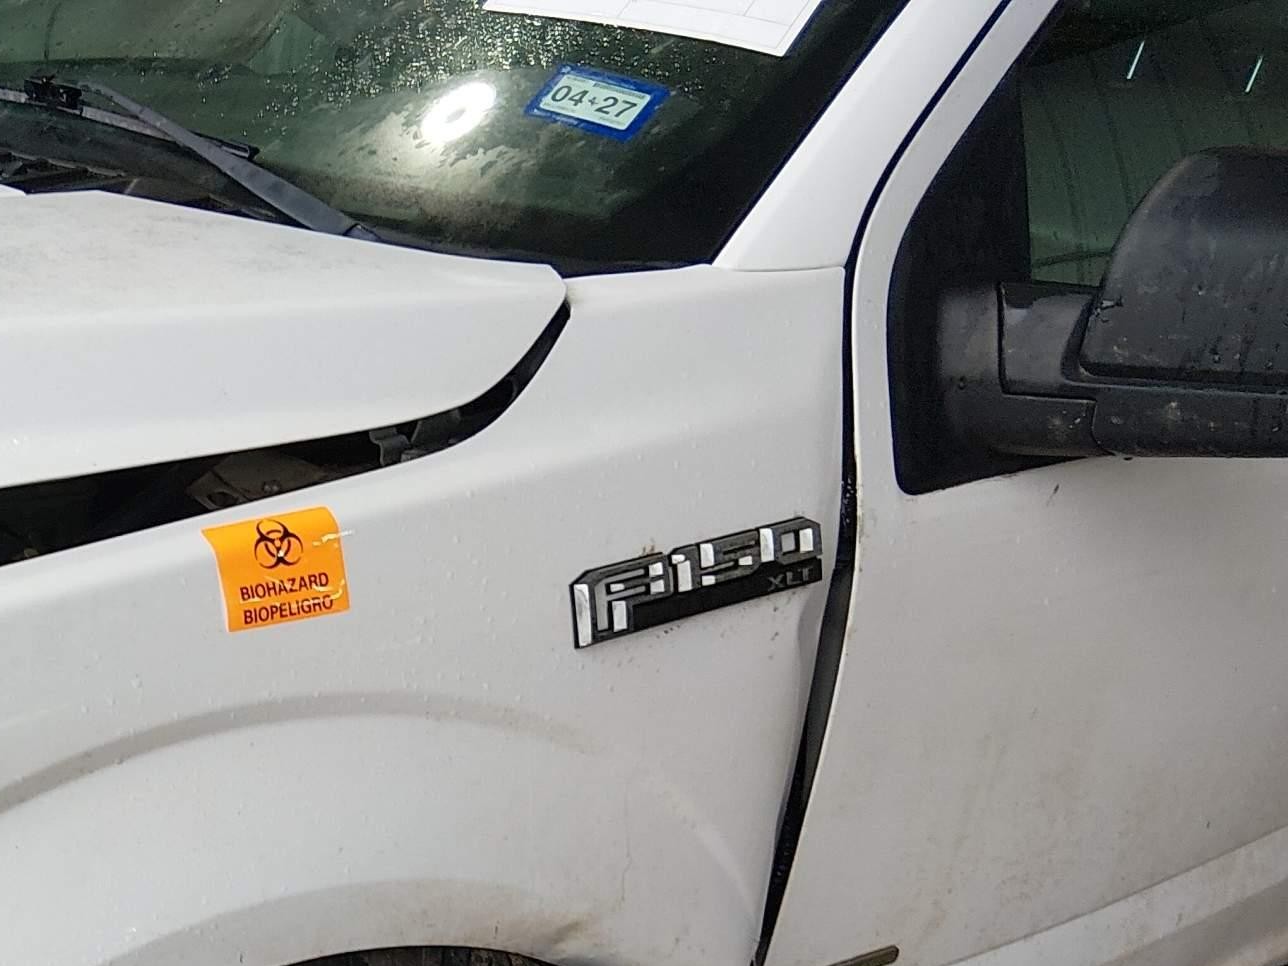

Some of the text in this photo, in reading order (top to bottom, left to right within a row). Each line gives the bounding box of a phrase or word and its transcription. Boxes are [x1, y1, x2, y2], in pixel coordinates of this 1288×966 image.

[239, 571, 330, 602] BIOHAZARD
[766, 566, 813, 592] XLT
[243, 594, 334, 626] BIOPELIGRO
